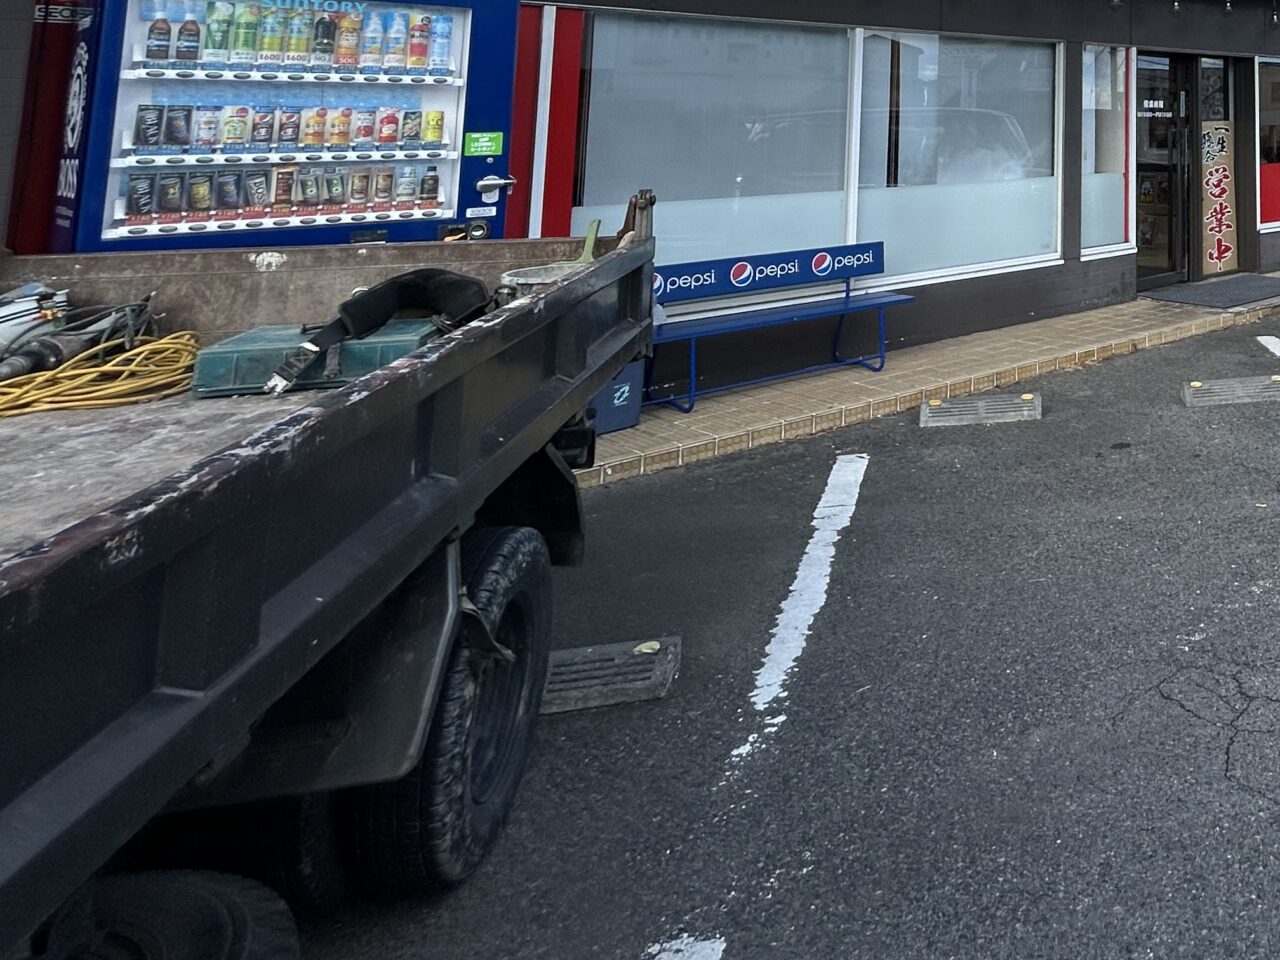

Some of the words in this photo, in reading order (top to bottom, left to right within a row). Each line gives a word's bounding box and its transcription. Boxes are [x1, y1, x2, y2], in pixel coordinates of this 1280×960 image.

[254, 180, 266, 205] BOSS
[1204, 166, 1233, 272] 営業中
[755, 259, 798, 281] pepsi
[834, 250, 874, 272] pepsi
[666, 269, 715, 292] pepsi
